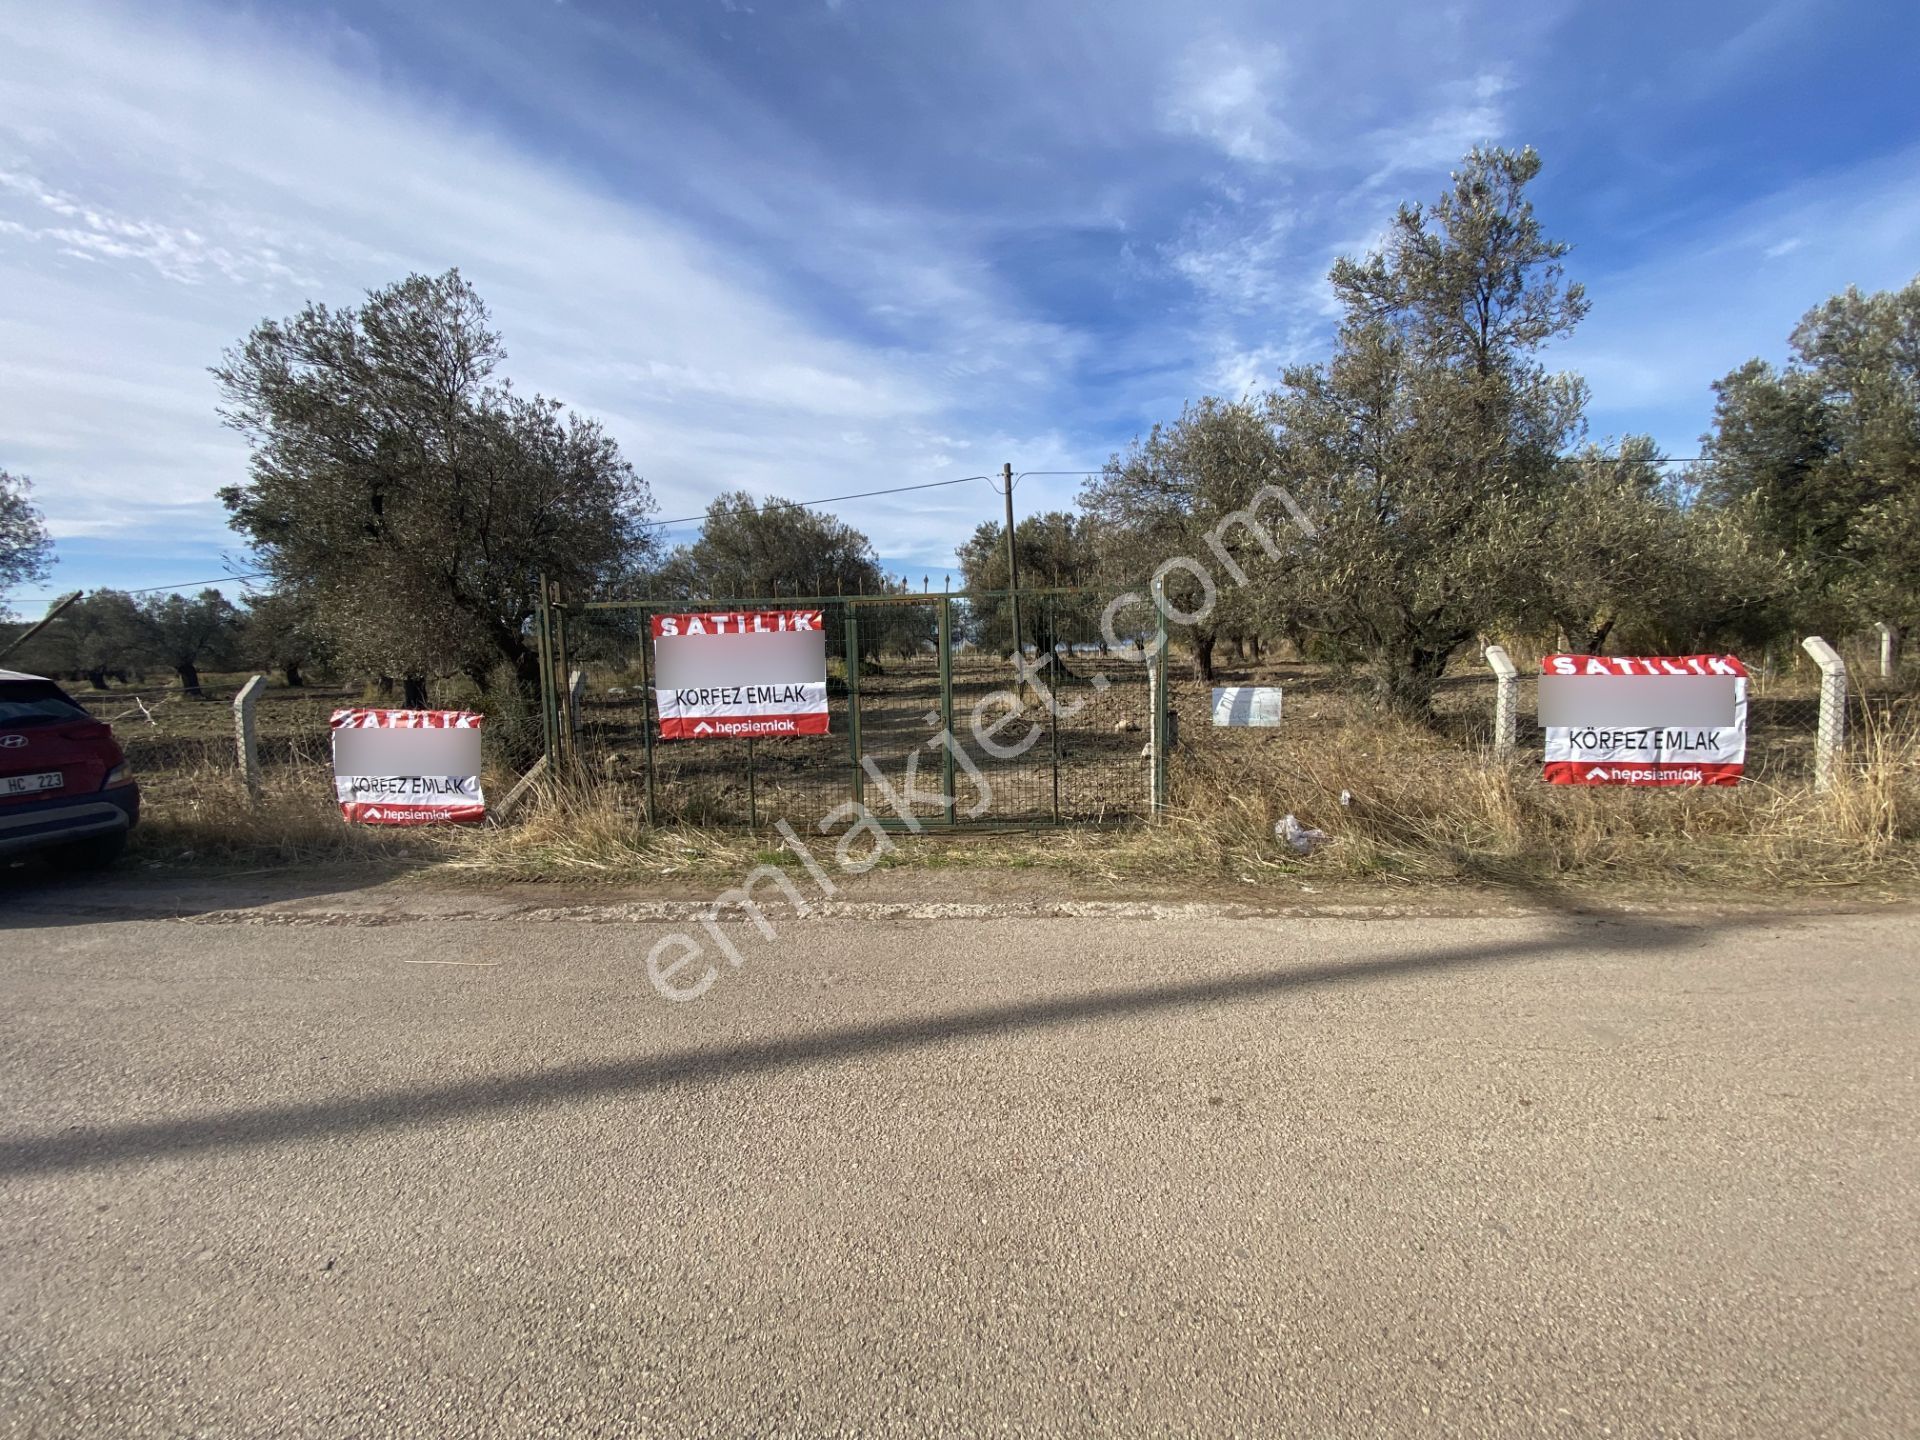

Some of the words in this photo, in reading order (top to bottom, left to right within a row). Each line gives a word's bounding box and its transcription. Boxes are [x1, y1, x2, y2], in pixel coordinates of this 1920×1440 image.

[660, 613, 814, 637] SATILIK
[747, 685, 806, 703] EMLAK
[716, 720, 795, 735] hepsiemlak
[1569, 726, 1649, 750] KÖRFEZ
[1654, 731, 1720, 750] EMLAK
[8, 777, 26, 792] HC
[37, 773, 62, 788] 223
[1611, 767, 1702, 783] hepsiemlak
[411, 777, 465, 794] EMLAK
[383, 808, 450, 821] hepsiemlak
